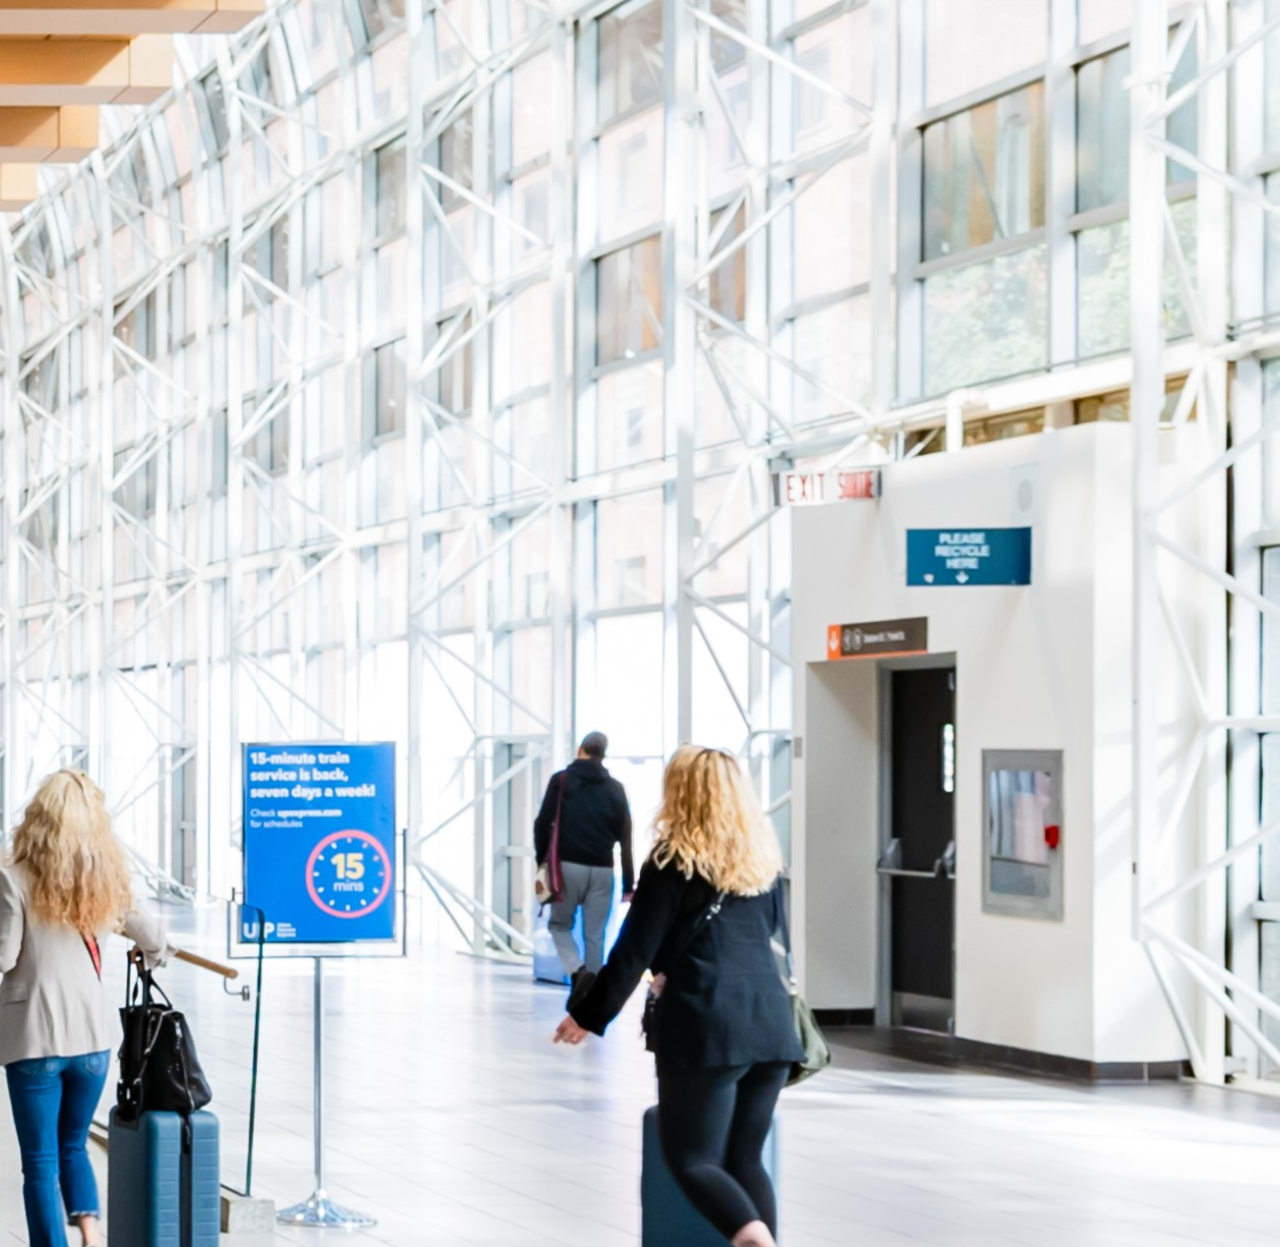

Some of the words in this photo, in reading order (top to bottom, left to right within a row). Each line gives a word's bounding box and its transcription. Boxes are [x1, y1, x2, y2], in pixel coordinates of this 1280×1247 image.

[786, 474, 824, 501] EXIT
[938, 533, 985, 545] PLEASE
[934, 545, 990, 557] RECYCLE
[946, 557, 979, 569] HERE
[250, 752, 316, 765] 15-minute
[318, 751, 350, 764] train
[250, 768, 297, 781] service
[299, 768, 311, 781] is
[312, 767, 349, 782] back,
[250, 787, 289, 798] seven
[291, 784, 322, 801] days
[324, 788, 333, 797] a
[335, 783, 376, 797] week!
[331, 853, 365, 880] 15
[333, 879, 364, 892] mins
[243, 922, 275, 939] UP
